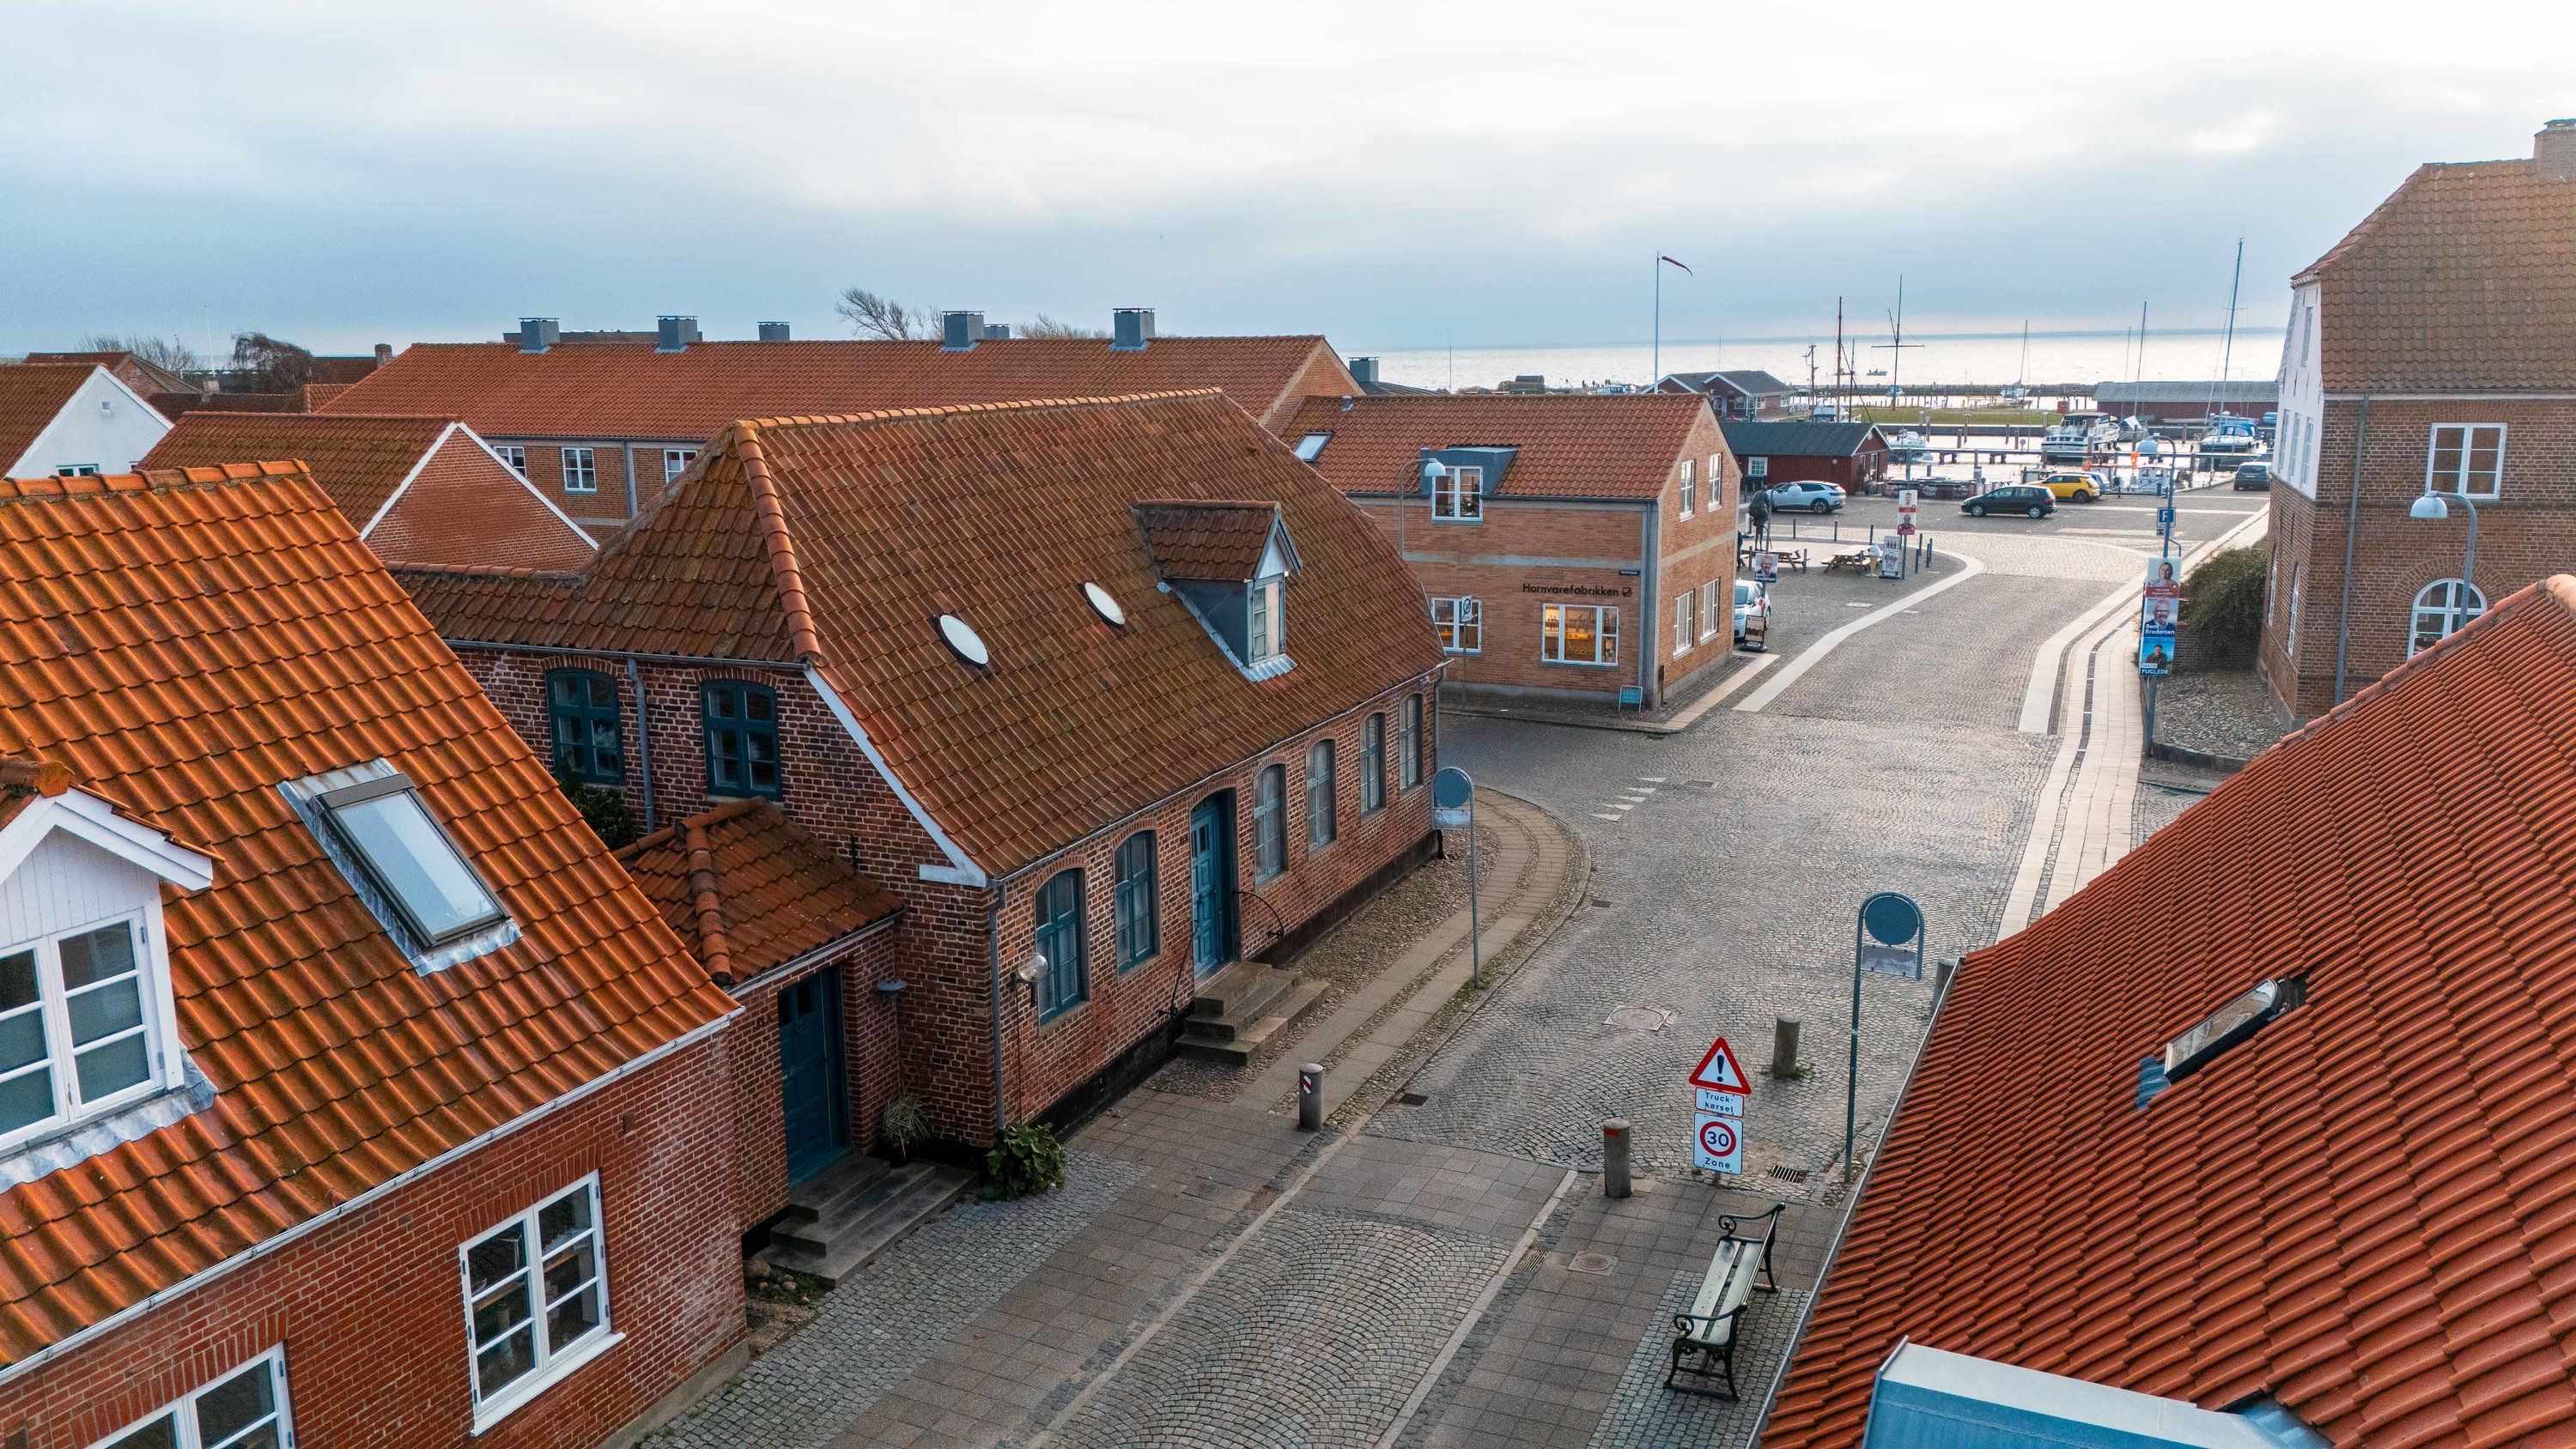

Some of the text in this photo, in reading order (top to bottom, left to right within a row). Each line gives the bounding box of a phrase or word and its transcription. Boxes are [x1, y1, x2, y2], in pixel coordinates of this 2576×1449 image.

[1522, 584, 1619, 597] Hornvarefabrikken
[1705, 1092, 1734, 1103] Truck-
[1704, 1101, 1734, 1113] kørsel
[1707, 1131, 1729, 1147] 30
[1704, 1157, 1730, 1168] Zone
